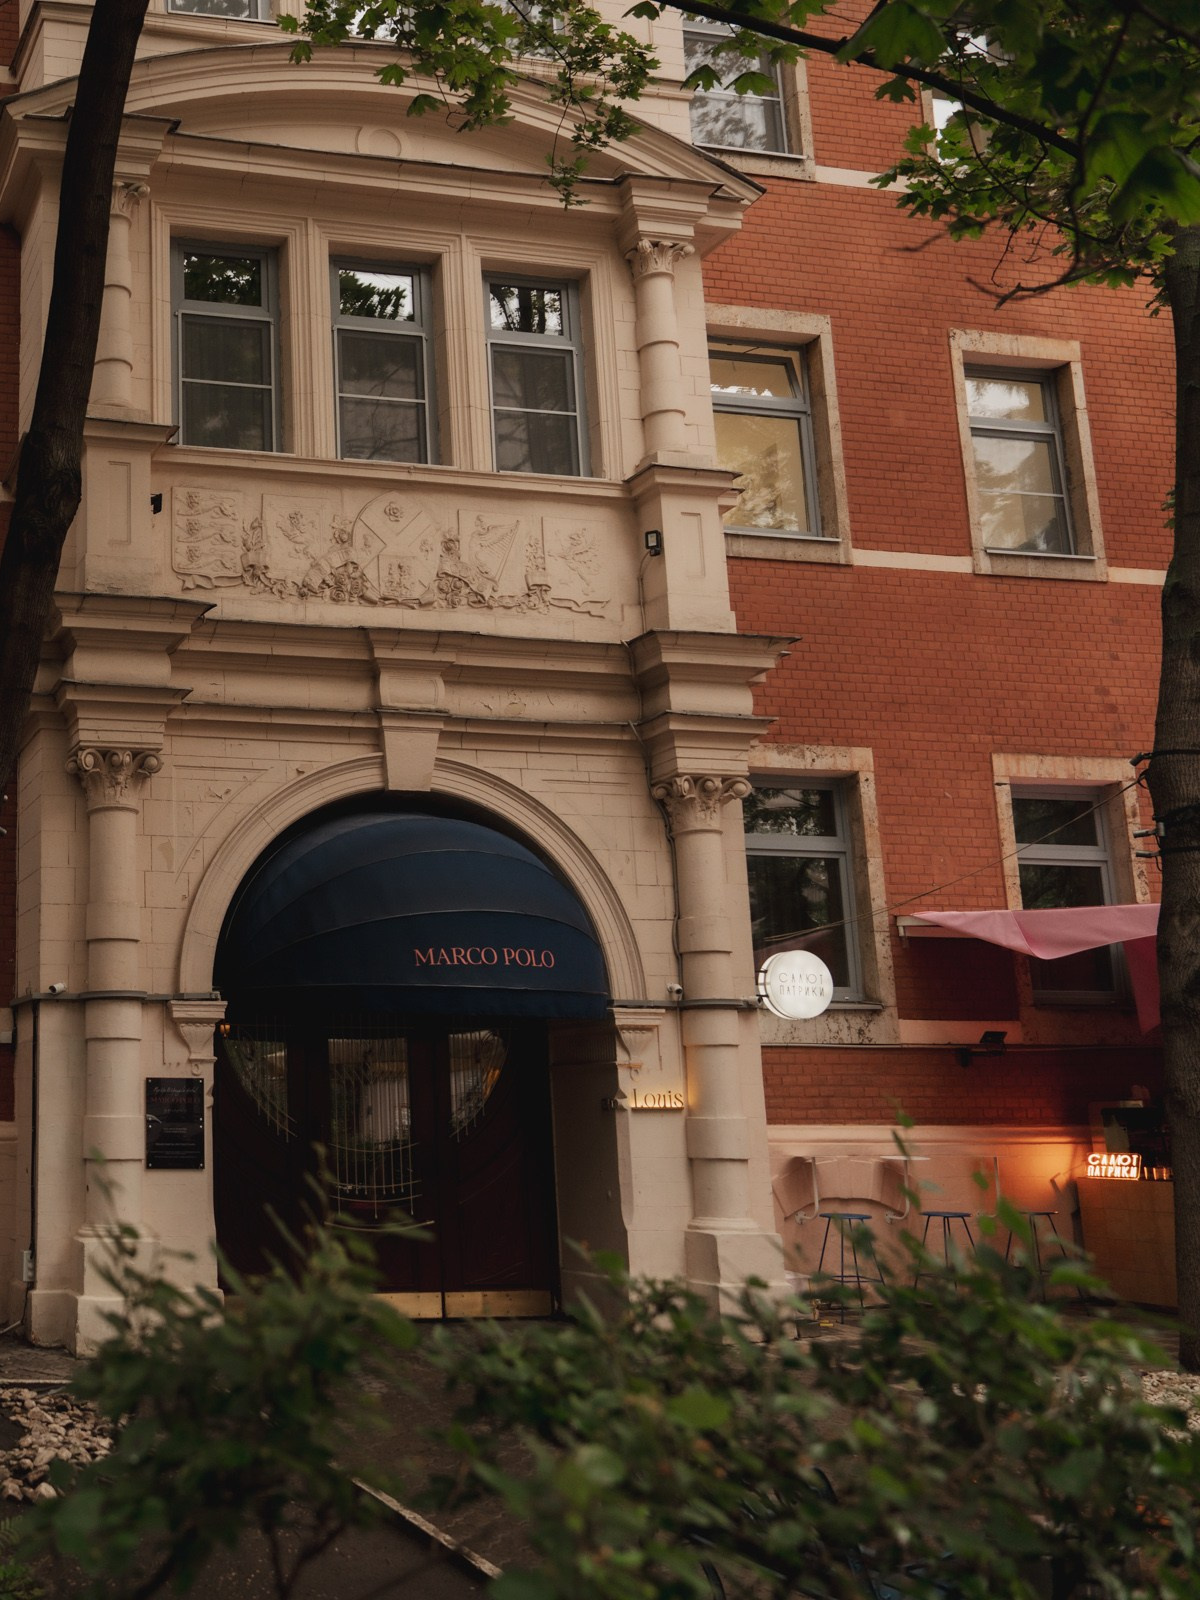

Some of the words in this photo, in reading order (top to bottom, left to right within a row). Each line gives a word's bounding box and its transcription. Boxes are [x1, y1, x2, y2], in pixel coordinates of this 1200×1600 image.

[413, 946, 498, 967] MARCO
[502, 947, 555, 968] POLO
[779, 972, 823, 985] САЛЮТ
[779, 985, 825, 997] ПАТРИКИ
[633, 1088, 684, 1109] Louis
[1088, 1154, 1139, 1166] САЛЮТ
[1087, 1166, 1138, 1178] ПАТРИКИ
